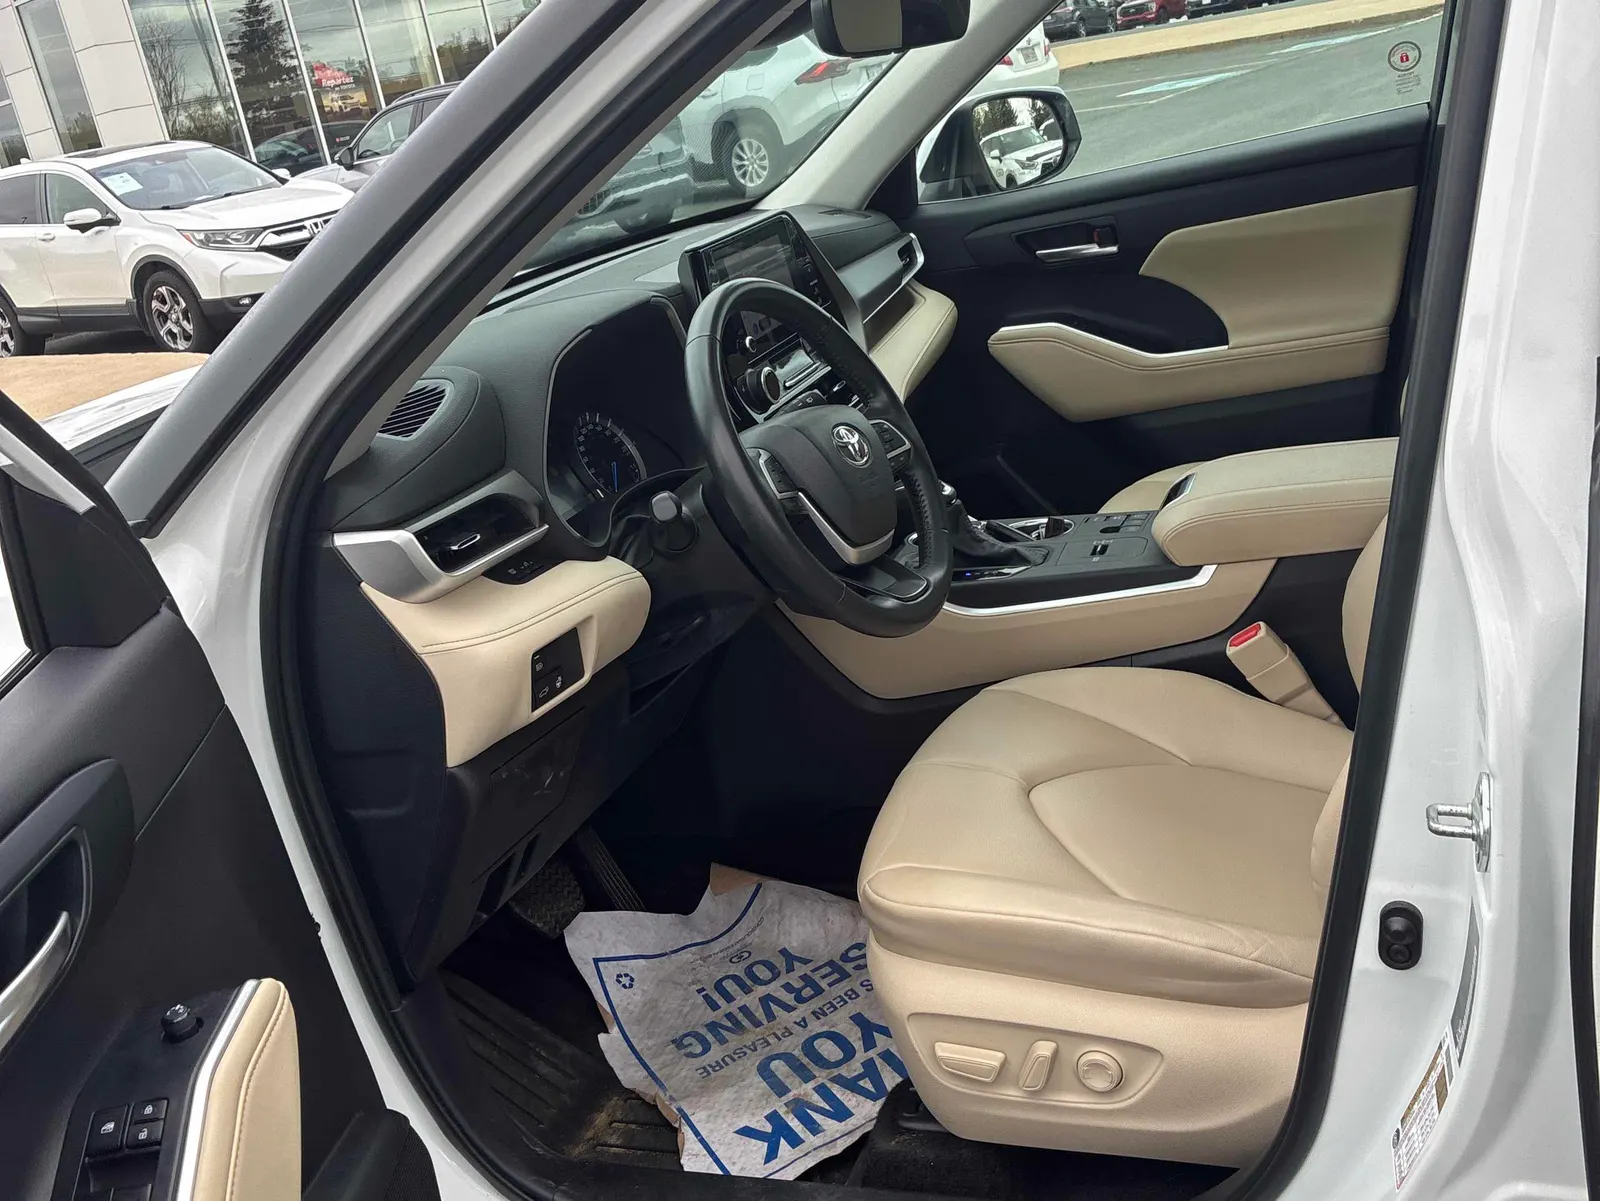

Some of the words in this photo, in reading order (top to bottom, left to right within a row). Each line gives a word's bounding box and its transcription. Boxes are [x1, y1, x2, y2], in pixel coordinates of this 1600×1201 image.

[670, 942, 867, 1059] SERVING
[696, 947, 814, 1013] YOU!
[811, 987, 861, 1020] BEEN
[695, 1025, 794, 1080] PLEASURE
[793, 1016, 809, 1029] A
[757, 1012, 892, 1099] YOU
